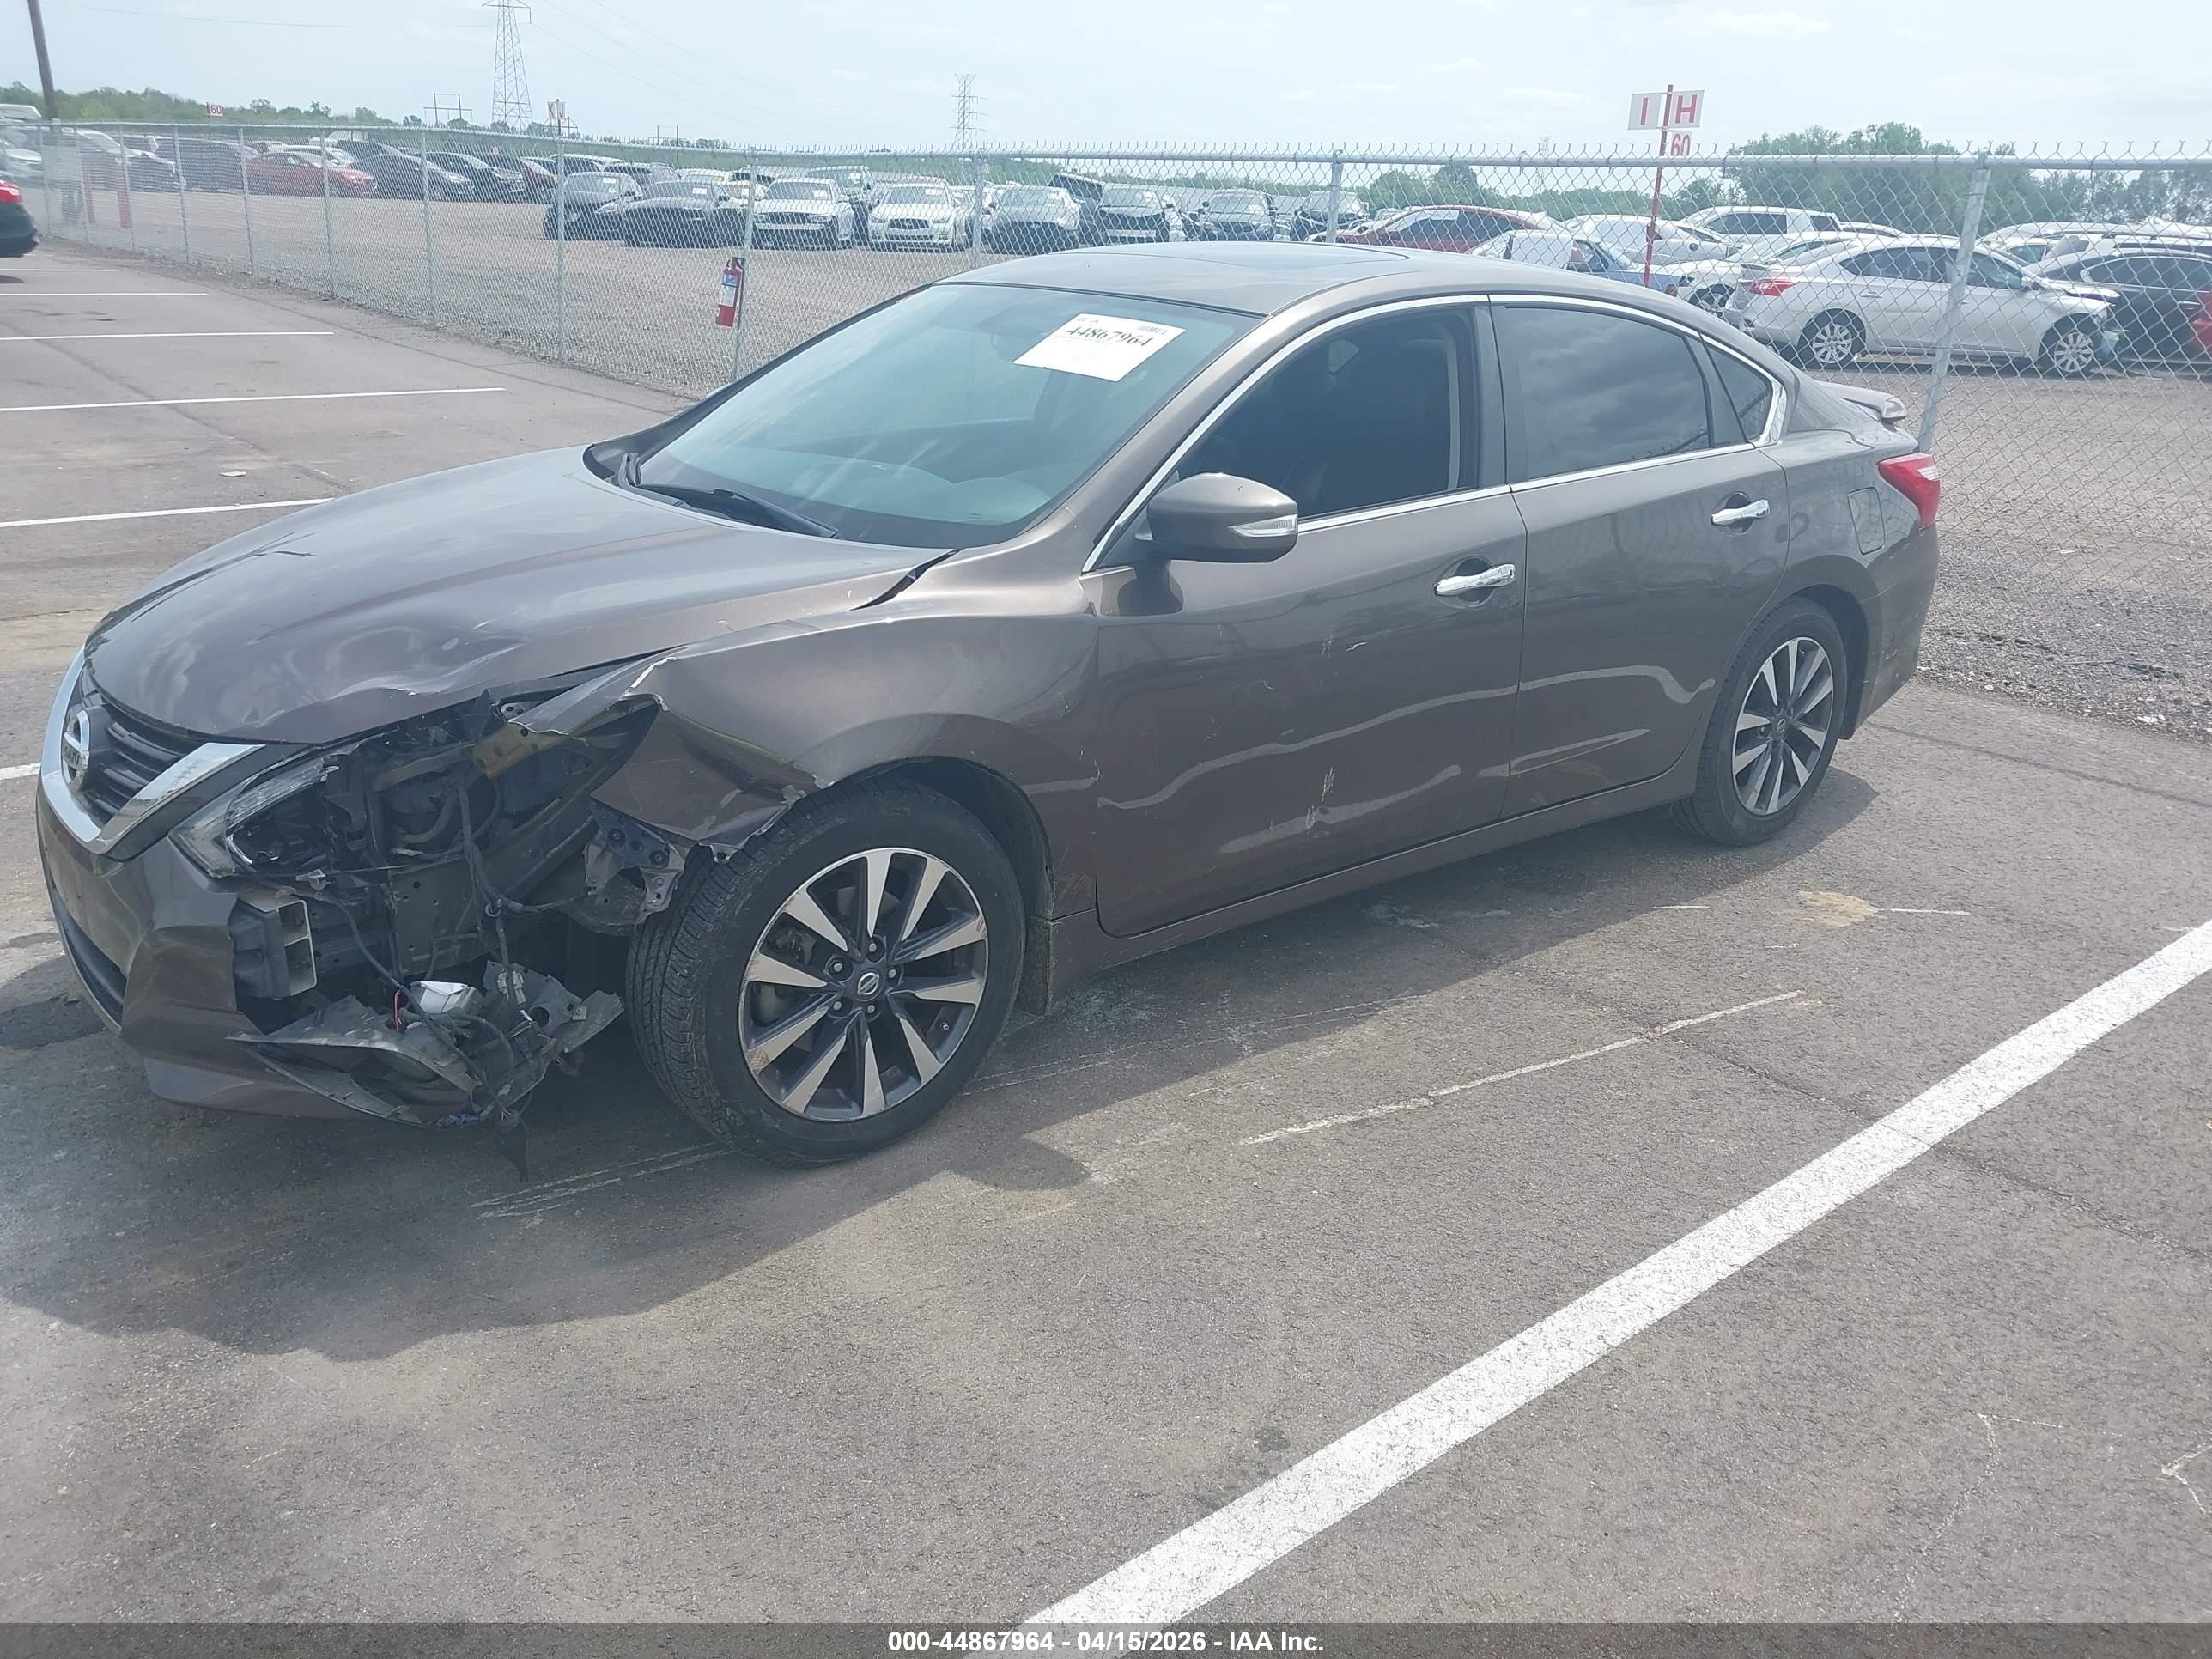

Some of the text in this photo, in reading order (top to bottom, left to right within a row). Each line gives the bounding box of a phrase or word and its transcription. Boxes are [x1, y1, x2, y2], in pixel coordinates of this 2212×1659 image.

[210, 104, 221, 114] 60
[548, 103, 555, 118] K
[1640, 94, 1698, 125] I H
[1670, 133, 1691, 156] 60
[1066, 325, 1154, 347] 44867964
